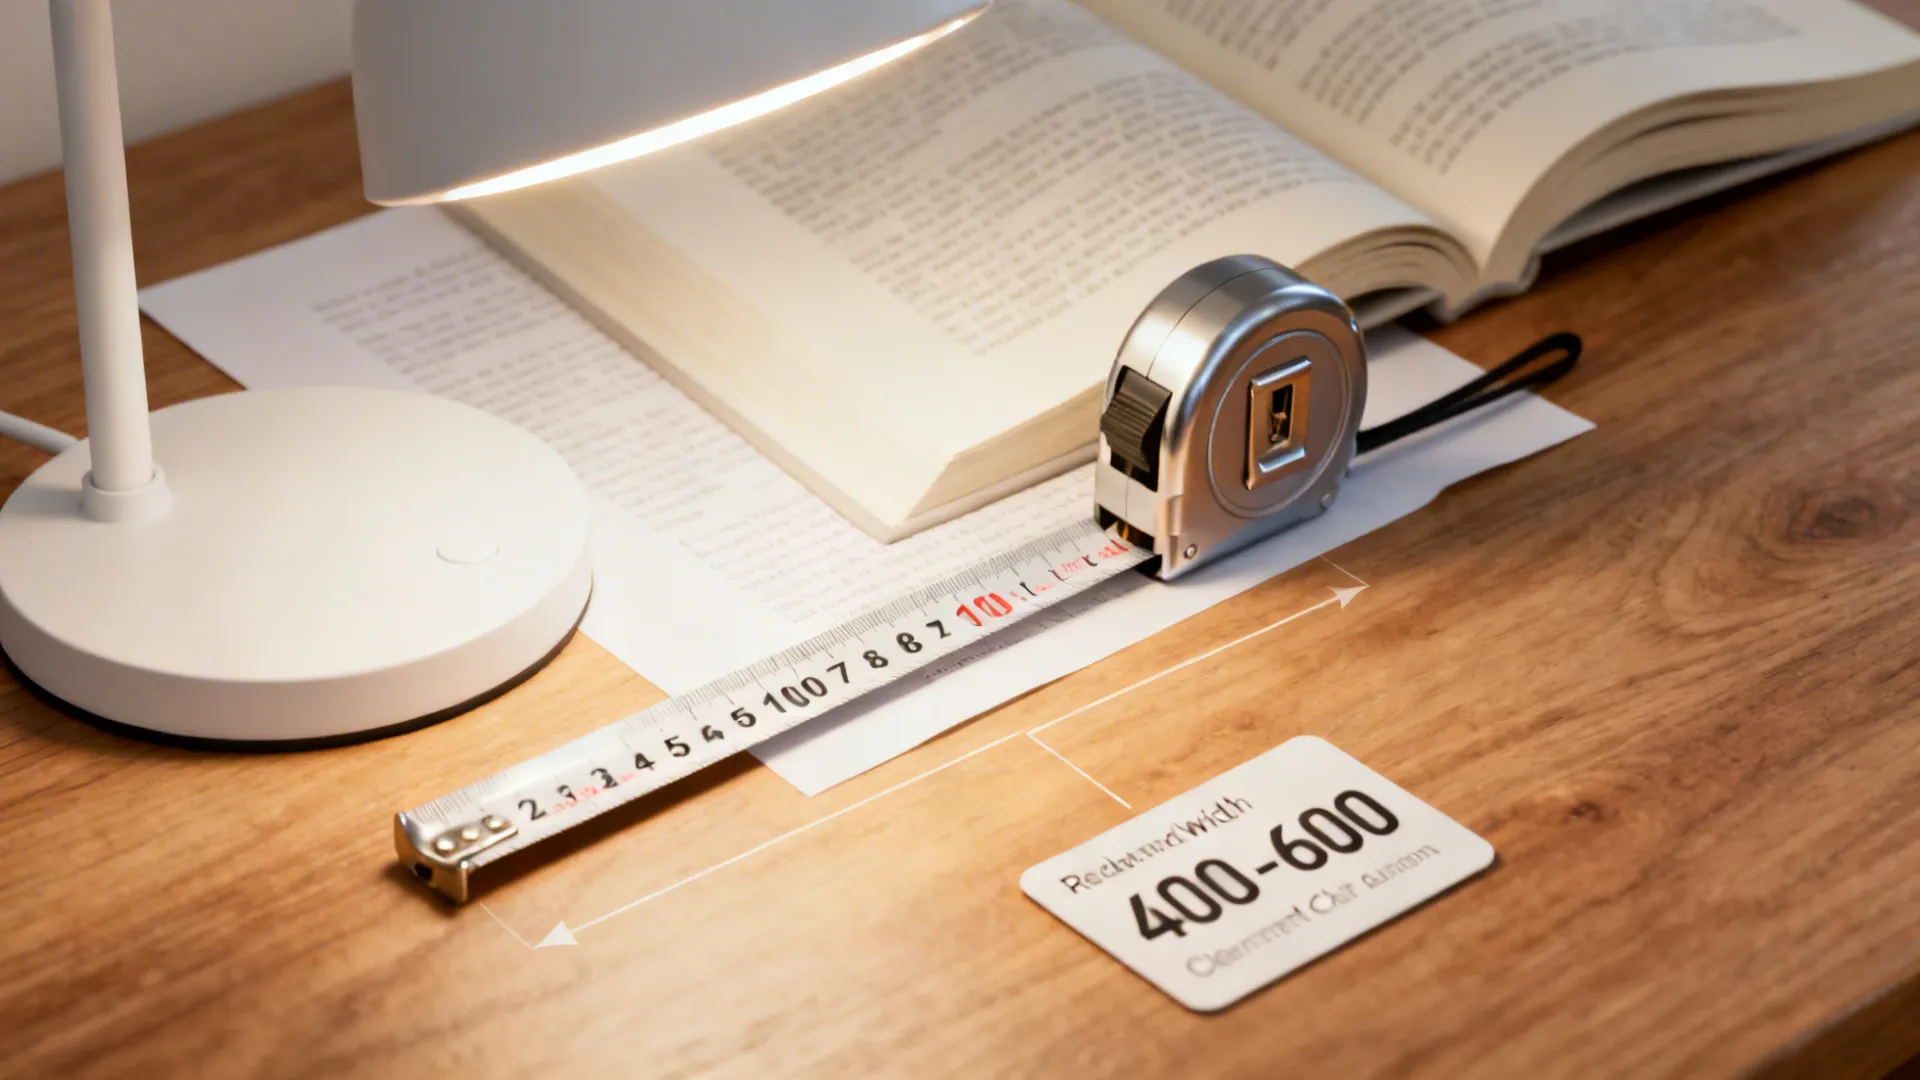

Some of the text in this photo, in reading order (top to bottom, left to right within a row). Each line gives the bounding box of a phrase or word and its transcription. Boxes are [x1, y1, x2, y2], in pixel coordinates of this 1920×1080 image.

[663, 735, 691, 758] 5
[730, 707, 757, 728] 5
[826, 661, 850, 684] 7
[863, 649, 889, 669] 8
[896, 632, 923, 654] 8
[1128, 788, 1401, 942] 400-600
